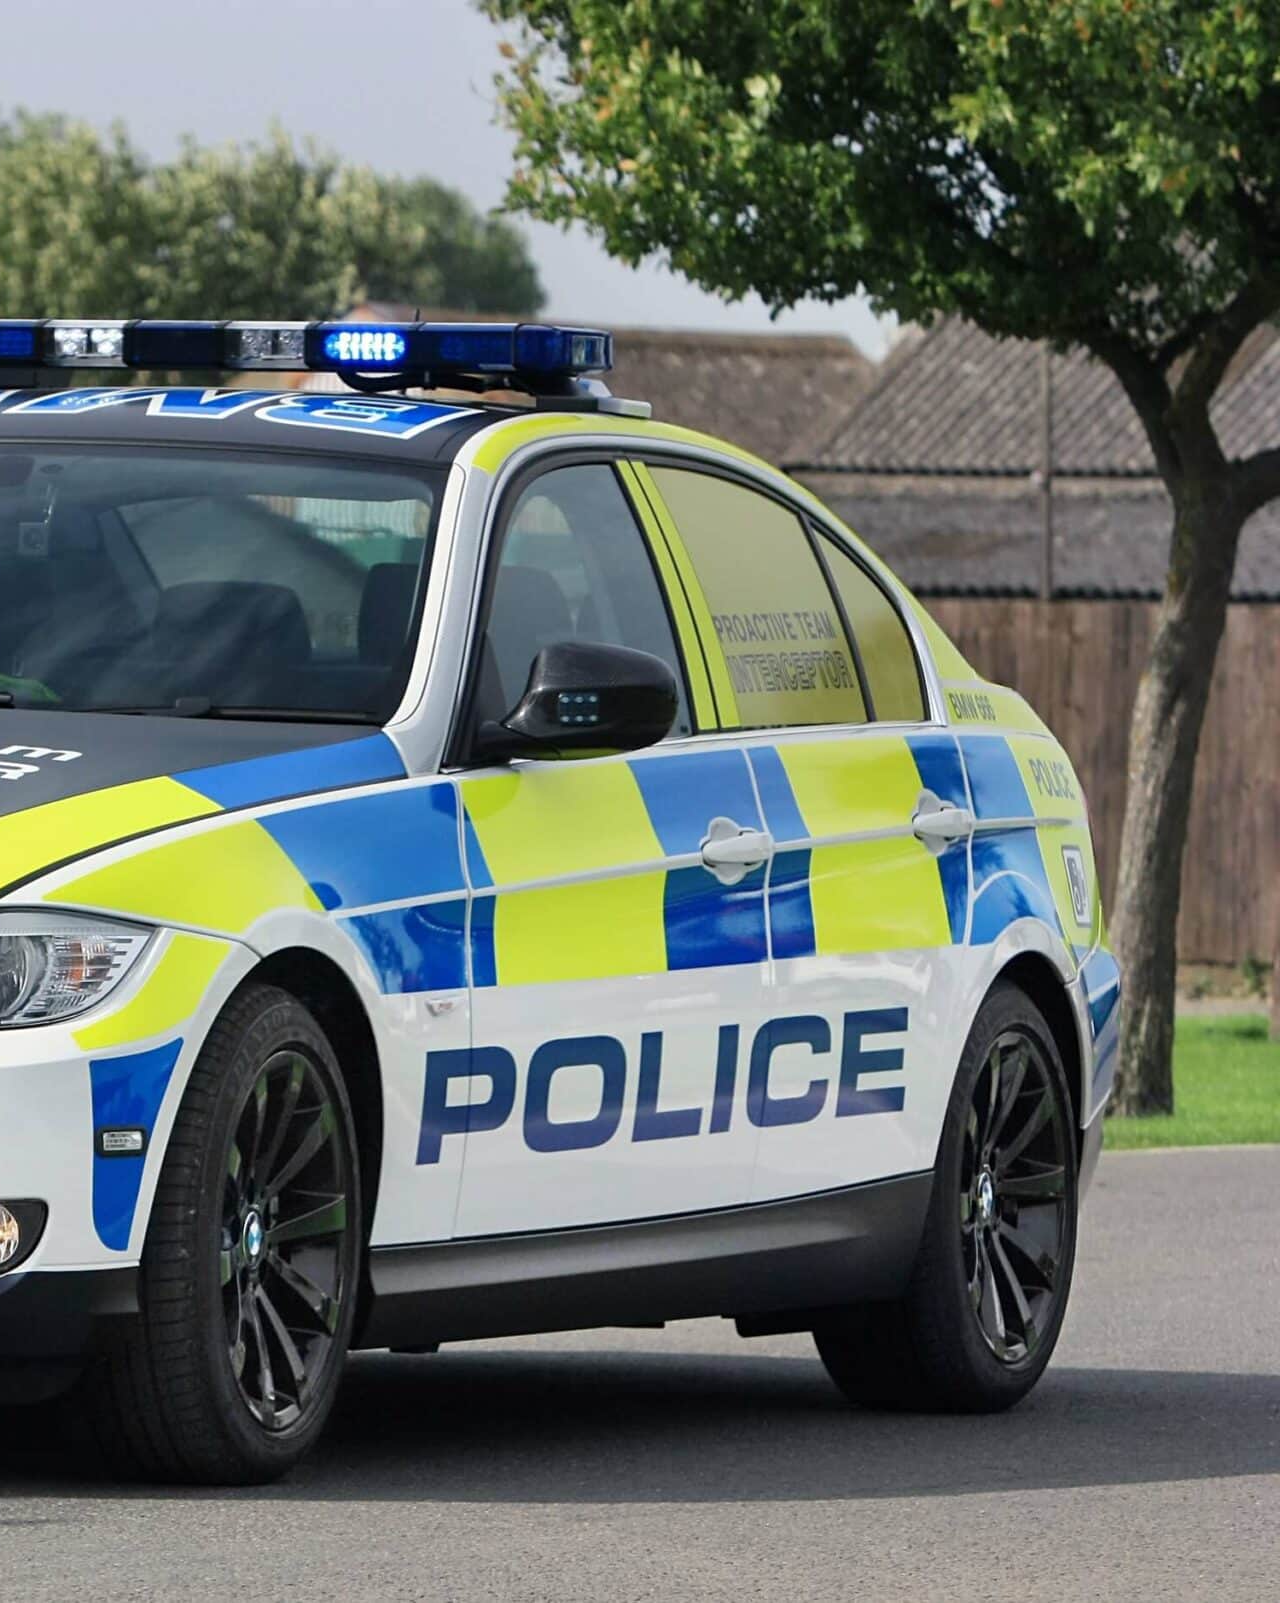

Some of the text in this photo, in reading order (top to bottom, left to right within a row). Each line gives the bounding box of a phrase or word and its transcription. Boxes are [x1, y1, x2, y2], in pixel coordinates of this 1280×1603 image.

[713, 610, 837, 643] PROACTIVE TEAM
[726, 651, 855, 694] INTERCEPTOR
[947, 692, 979, 720] BMW
[414, 1006, 910, 1167] POLICE
